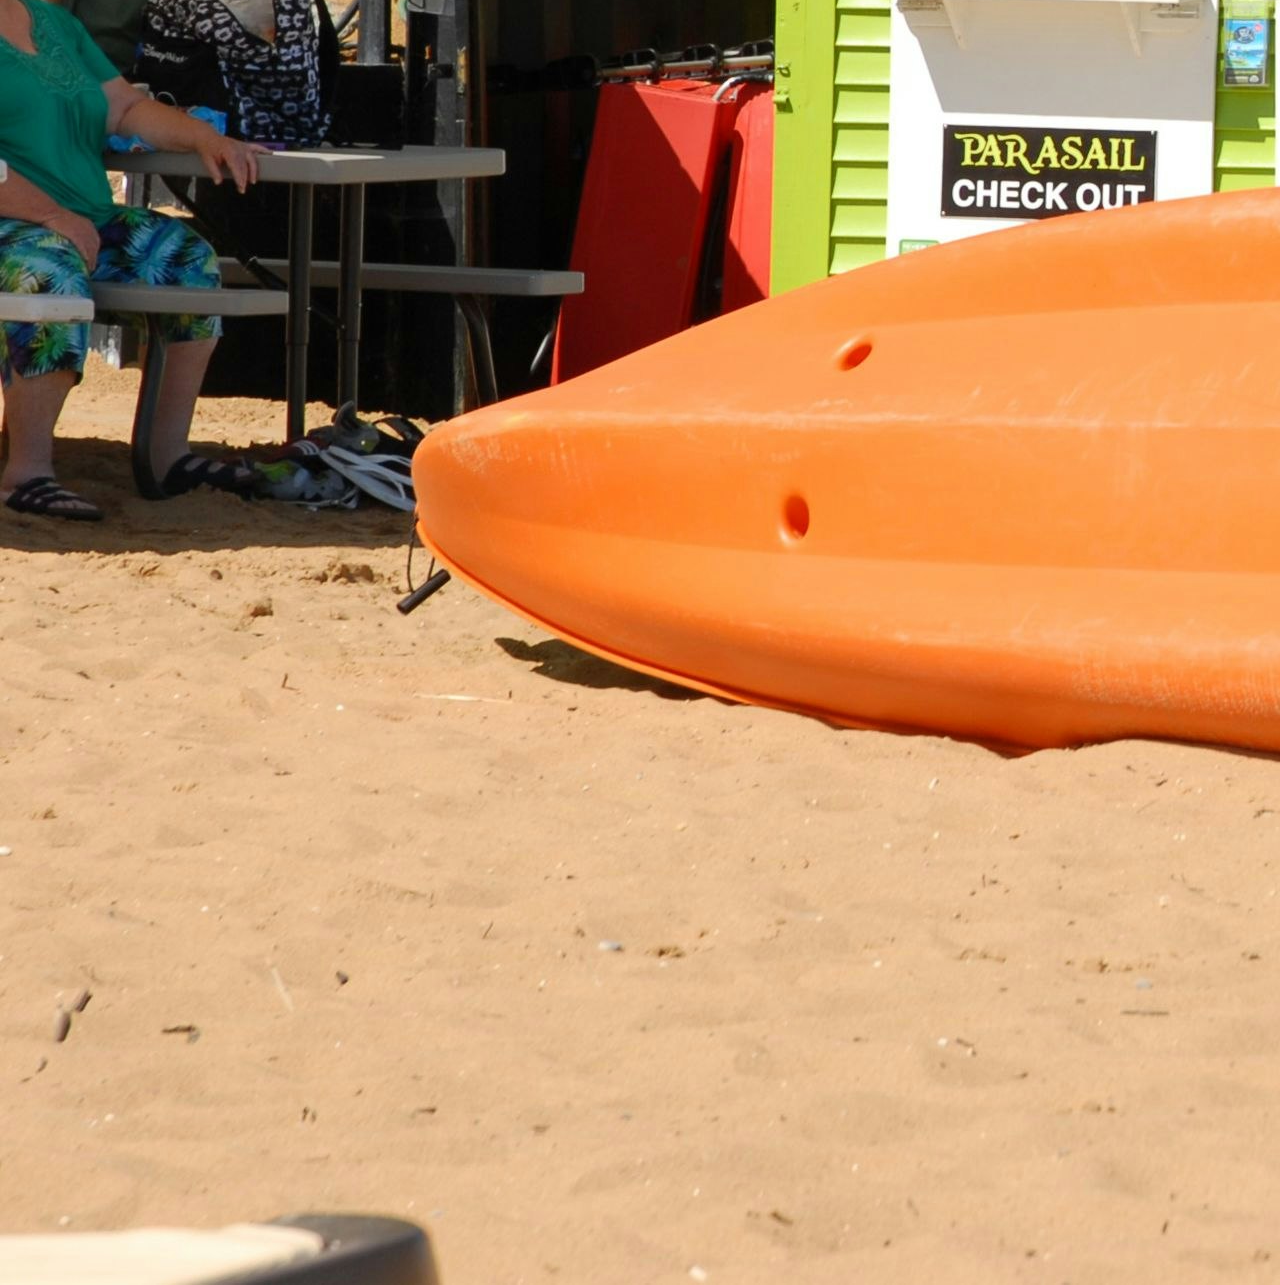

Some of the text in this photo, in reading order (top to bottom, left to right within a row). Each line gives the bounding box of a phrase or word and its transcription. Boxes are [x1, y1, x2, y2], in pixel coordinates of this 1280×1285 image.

[953, 131, 1146, 175] PARASAIL
[951, 179, 1147, 212] CHECK OUT
